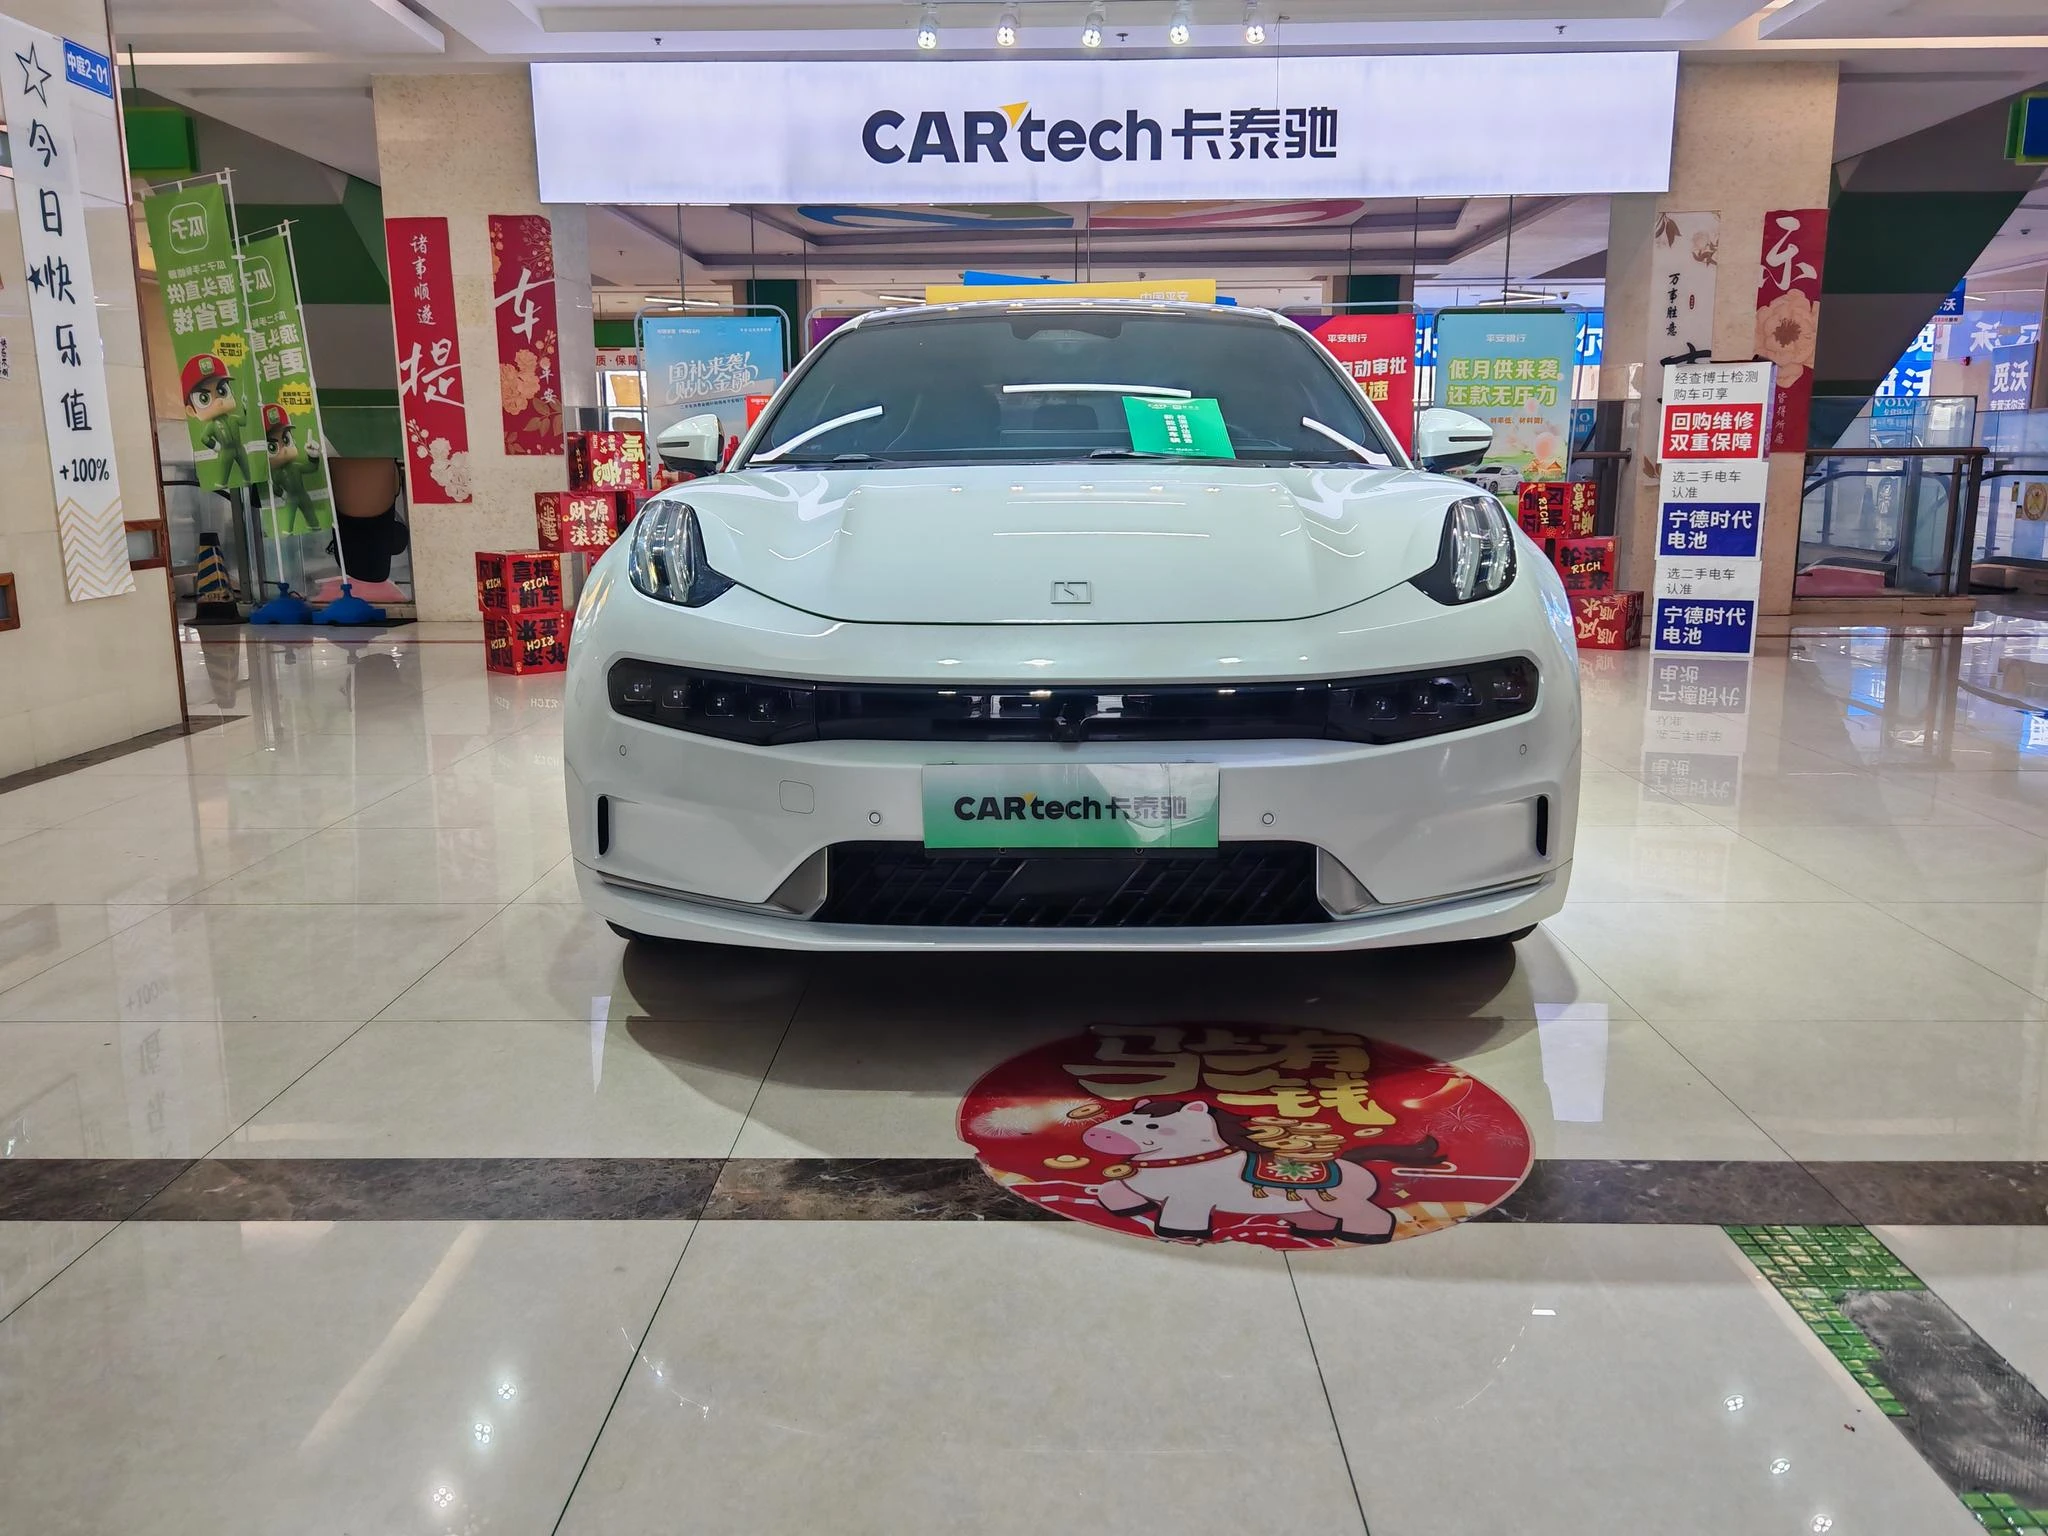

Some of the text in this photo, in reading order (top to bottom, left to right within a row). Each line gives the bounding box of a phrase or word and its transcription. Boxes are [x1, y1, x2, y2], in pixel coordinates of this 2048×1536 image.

[67, 51, 109, 86] 中庭2-01
[862, 104, 1337, 164] CARtech 卡泰驰
[29, 118, 92, 431] 今日快乐值
[410, 234, 436, 326] 诸事顺遂
[494, 268, 556, 343] 车
[1665, 273, 1681, 337] 万事胜意
[1327, 333, 1368, 343] 平安银行
[1486, 334, 1527, 343] 平安银行
[399, 338, 465, 408] 提
[668, 351, 751, 384] 国补来袭!
[1448, 358, 1560, 381] 低月供来袭
[1675, 370, 1758, 385] 经查博士检测
[1992, 360, 2029, 393] 觅沃
[540, 367, 558, 405] 平安
[667, 370, 757, 403] 贴心金融
[1447, 385, 1558, 406] 还款无压力
[1673, 388, 1728, 400] 购车可享
[1671, 411, 1754, 431] 回购维修
[1669, 432, 1752, 452] 双重保障
[59, 458, 110, 482] +100%
[1672, 470, 1741, 483] 选二手电车
[1672, 487, 1698, 499] 认准
[569, 498, 609, 522] 财源
[1538, 496, 1549, 525] RICH
[1669, 510, 1752, 529] 宁德时代
[570, 525, 611, 546] 滚滚
[1667, 531, 1708, 549] 电池
[1571, 561, 1600, 574] RICH
[1667, 568, 1735, 580] 选二手电车
[485, 577, 501, 590] RICH
[522, 575, 549, 592] RICH
[1666, 583, 1693, 595] 认准
[1664, 606, 1746, 626] 宁德时代
[526, 635, 555, 651] RICH
[1662, 626, 1702, 645] 电池
[954, 795, 1187, 821] CARtech 卡泰驰
